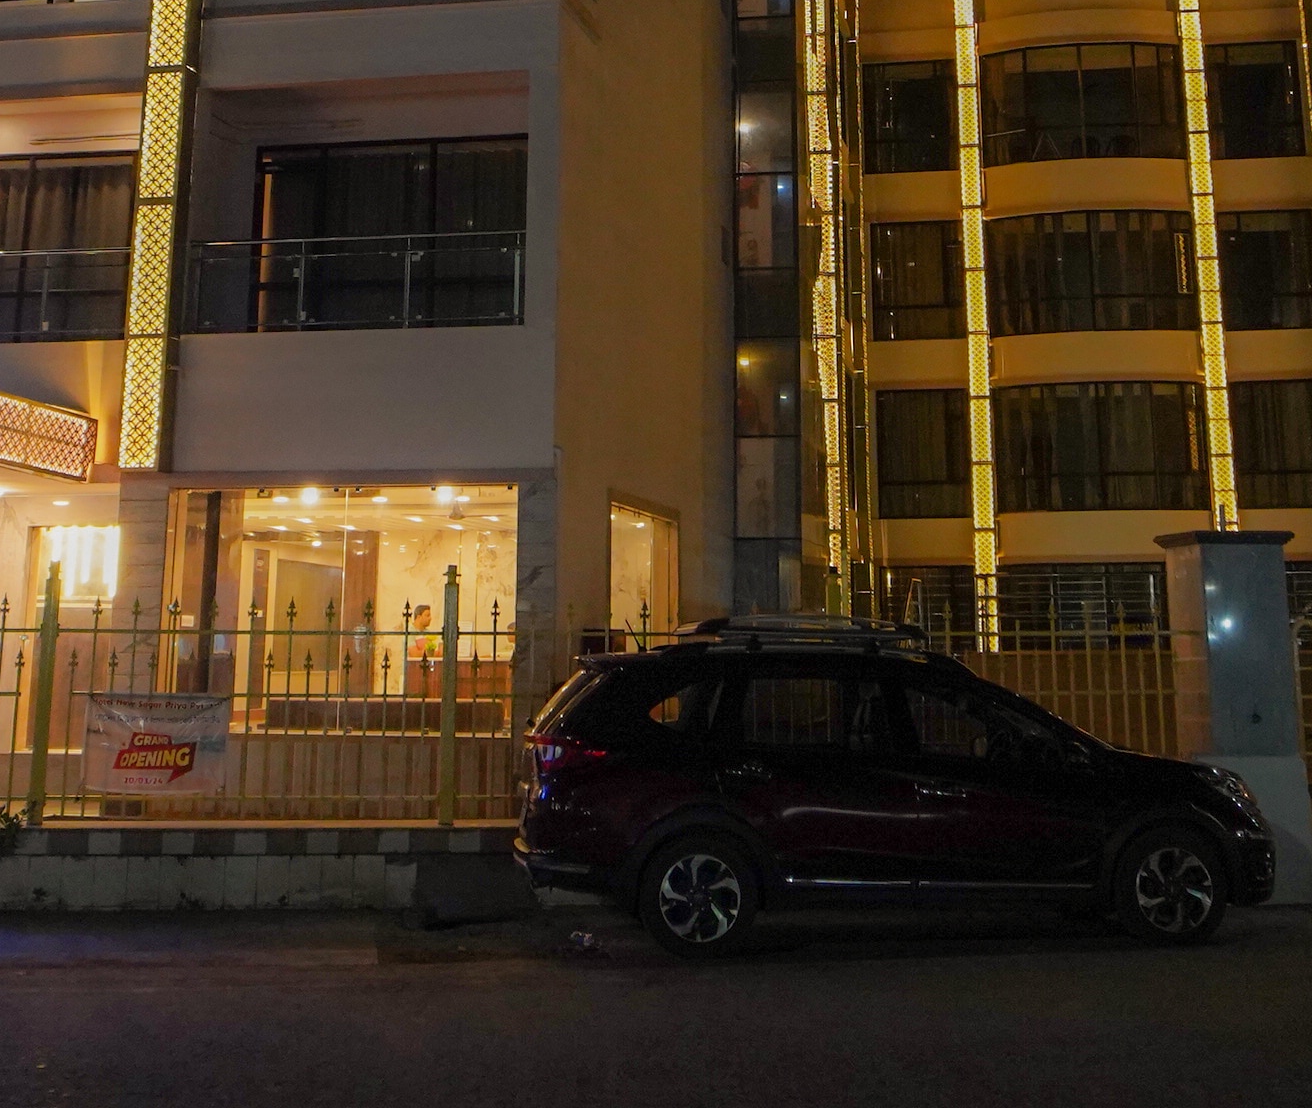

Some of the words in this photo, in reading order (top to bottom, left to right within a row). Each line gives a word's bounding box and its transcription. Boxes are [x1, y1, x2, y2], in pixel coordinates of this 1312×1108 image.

[116, 699, 135, 707] New
[138, 700, 162, 710] Sagar
[133, 735, 169, 746] GRAND
[119, 747, 190, 767] OPENING
